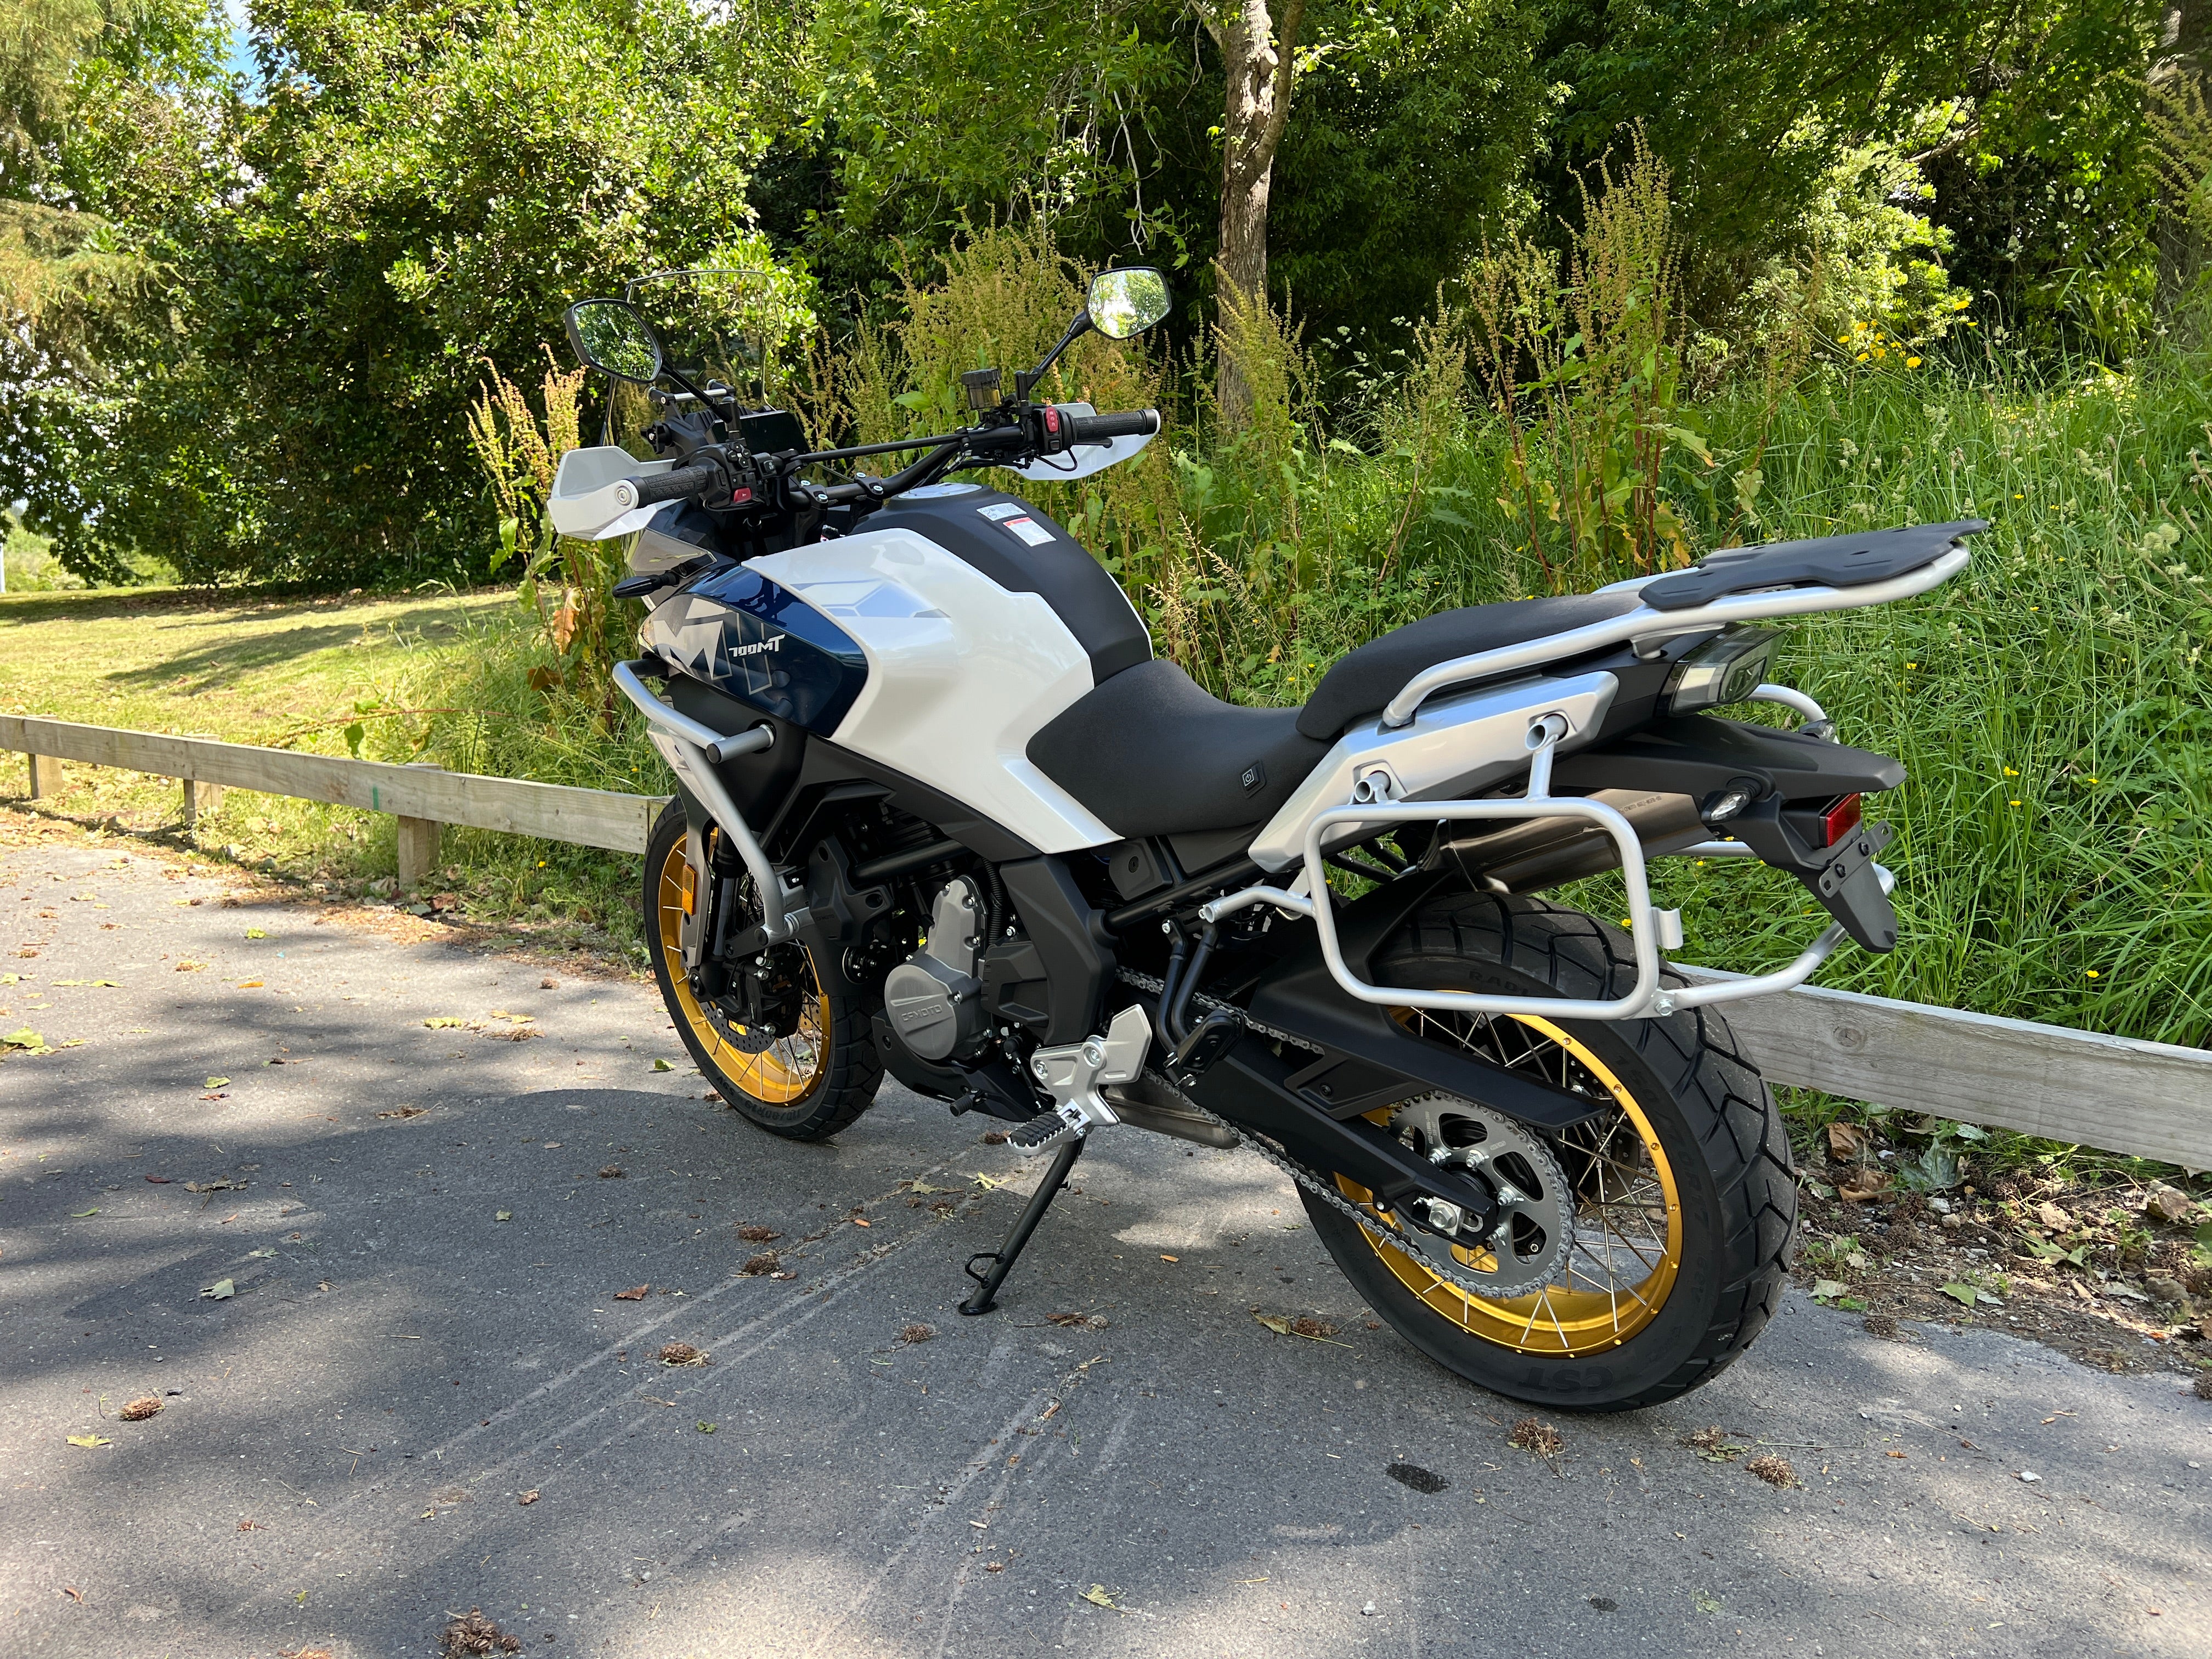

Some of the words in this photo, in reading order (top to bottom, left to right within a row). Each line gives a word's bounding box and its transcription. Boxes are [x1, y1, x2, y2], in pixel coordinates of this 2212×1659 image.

[728, 634, 786, 657] 700MT
[901, 1004, 943, 1022] CFMOTO
[1518, 1367, 1614, 1395] CST
